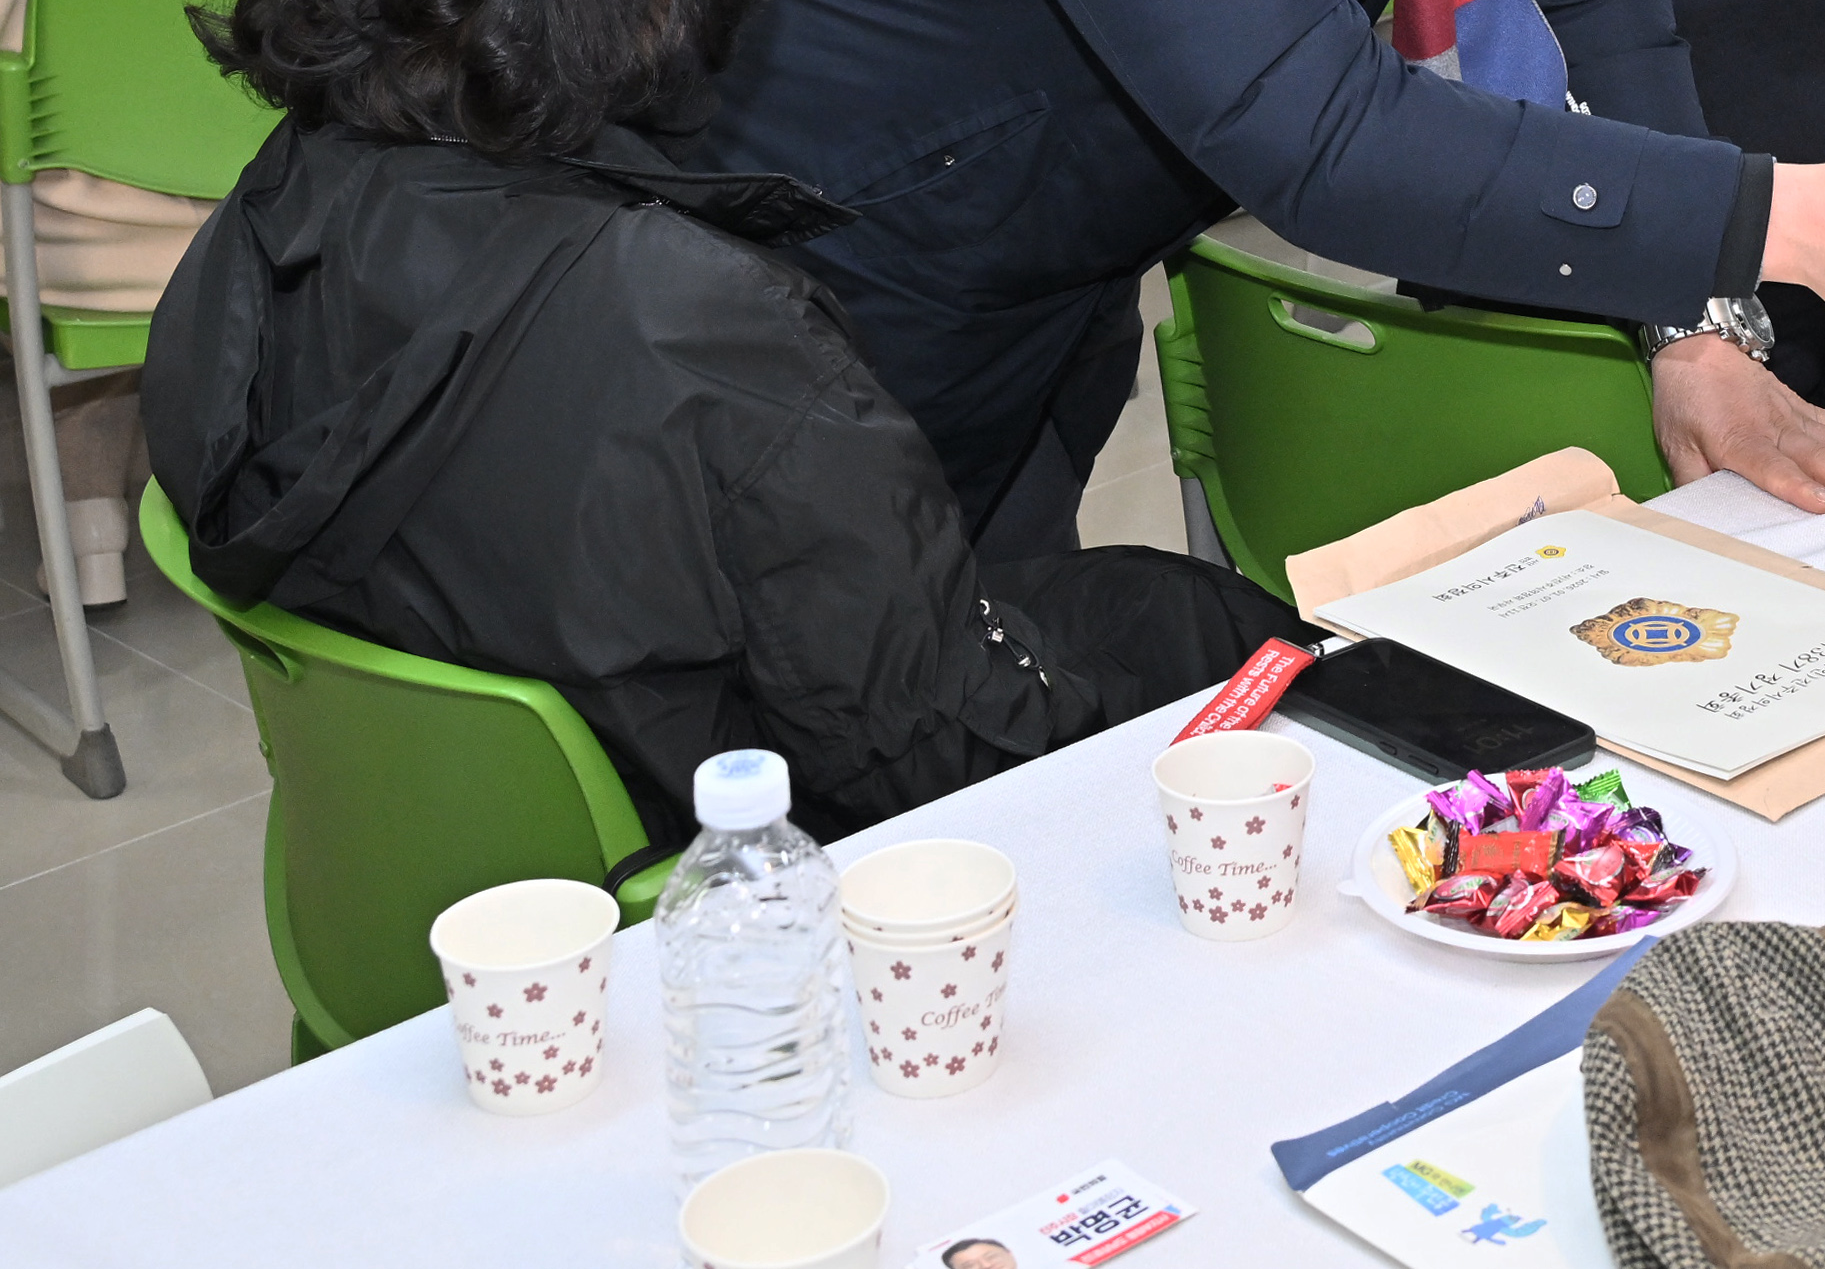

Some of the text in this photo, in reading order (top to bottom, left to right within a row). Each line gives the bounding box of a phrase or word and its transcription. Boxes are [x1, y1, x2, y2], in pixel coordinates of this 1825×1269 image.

[1432, 563, 1526, 602] 진주시의정회
[1248, 649, 1280, 677] Rests
[1219, 656, 1296, 730] The Future of the
[1229, 676, 1255, 700] with
[1696, 673, 1782, 713] 정기총회
[1215, 697, 1237, 714] the
[1218, 861, 1277, 877] Time...
[921, 1002, 980, 1030] Coffee
[496, 1030, 567, 1047] Time...
[1050, 1195, 1150, 1247] 박명균
